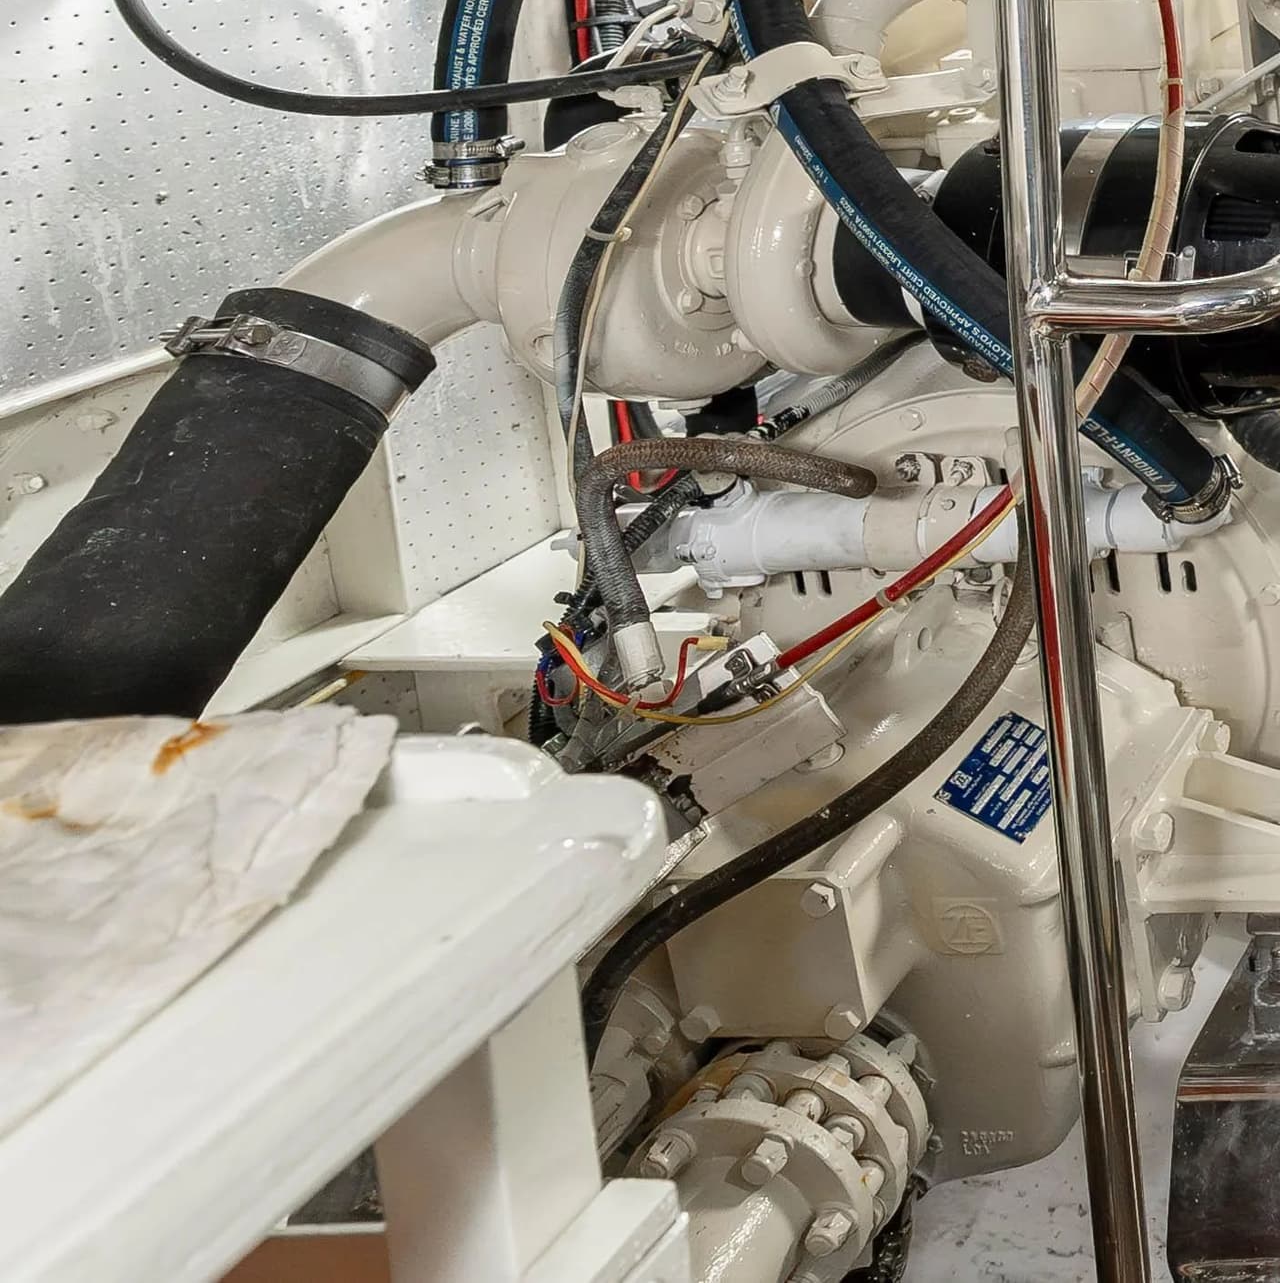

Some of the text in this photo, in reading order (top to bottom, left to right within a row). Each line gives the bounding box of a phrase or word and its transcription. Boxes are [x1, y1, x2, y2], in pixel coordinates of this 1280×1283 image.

[456, 19, 472, 46] WATER
[468, 18, 485, 65] APPROVED
[452, 55, 465, 89] XHAUST
[900, 266, 924, 288] CERT
[923, 286, 973, 328] APPROVED
[971, 326, 1012, 361] LLOYD'S
[1085, 418, 1163, 481] TRIDENT-FLE
